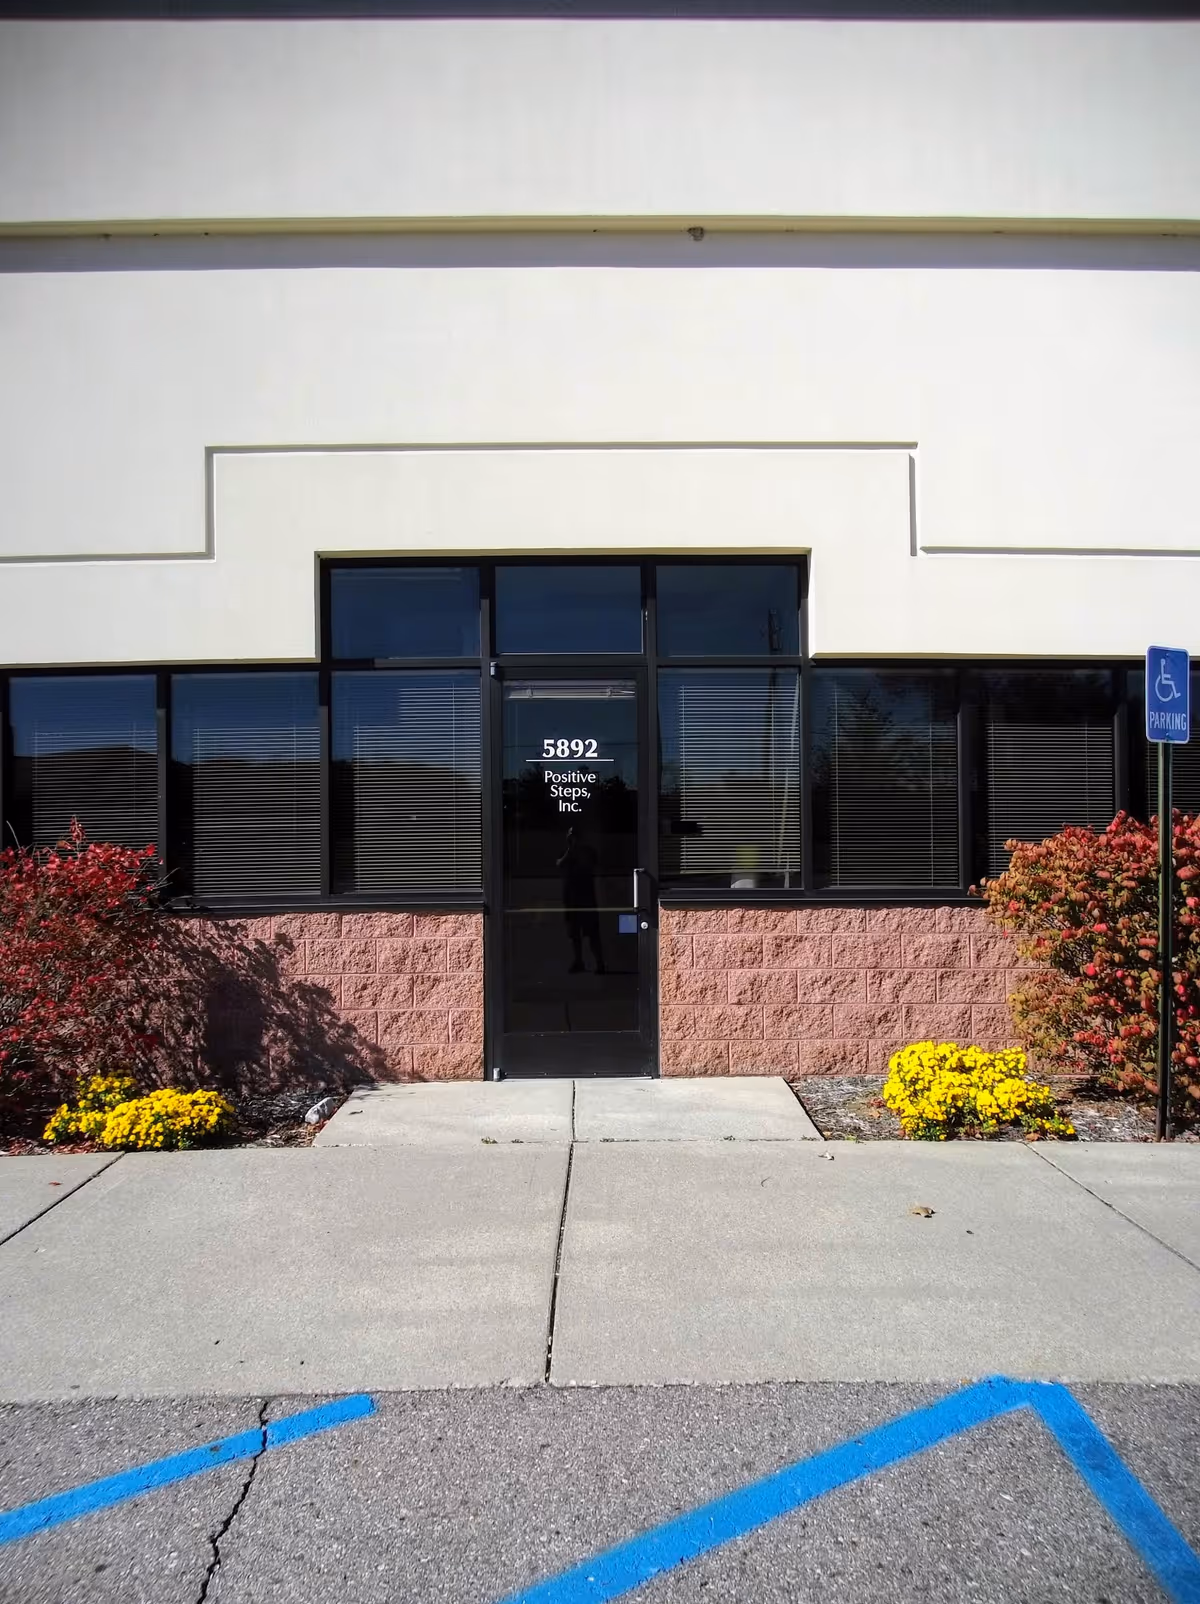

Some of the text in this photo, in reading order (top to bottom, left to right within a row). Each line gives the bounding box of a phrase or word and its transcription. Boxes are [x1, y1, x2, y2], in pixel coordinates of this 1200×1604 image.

[1149, 711, 1187, 731] PARKING
[542, 738, 598, 758] 5892
[544, 770, 597, 783] Positive
[550, 784, 591, 801] Steps,
[559, 799, 582, 812] Inc.
